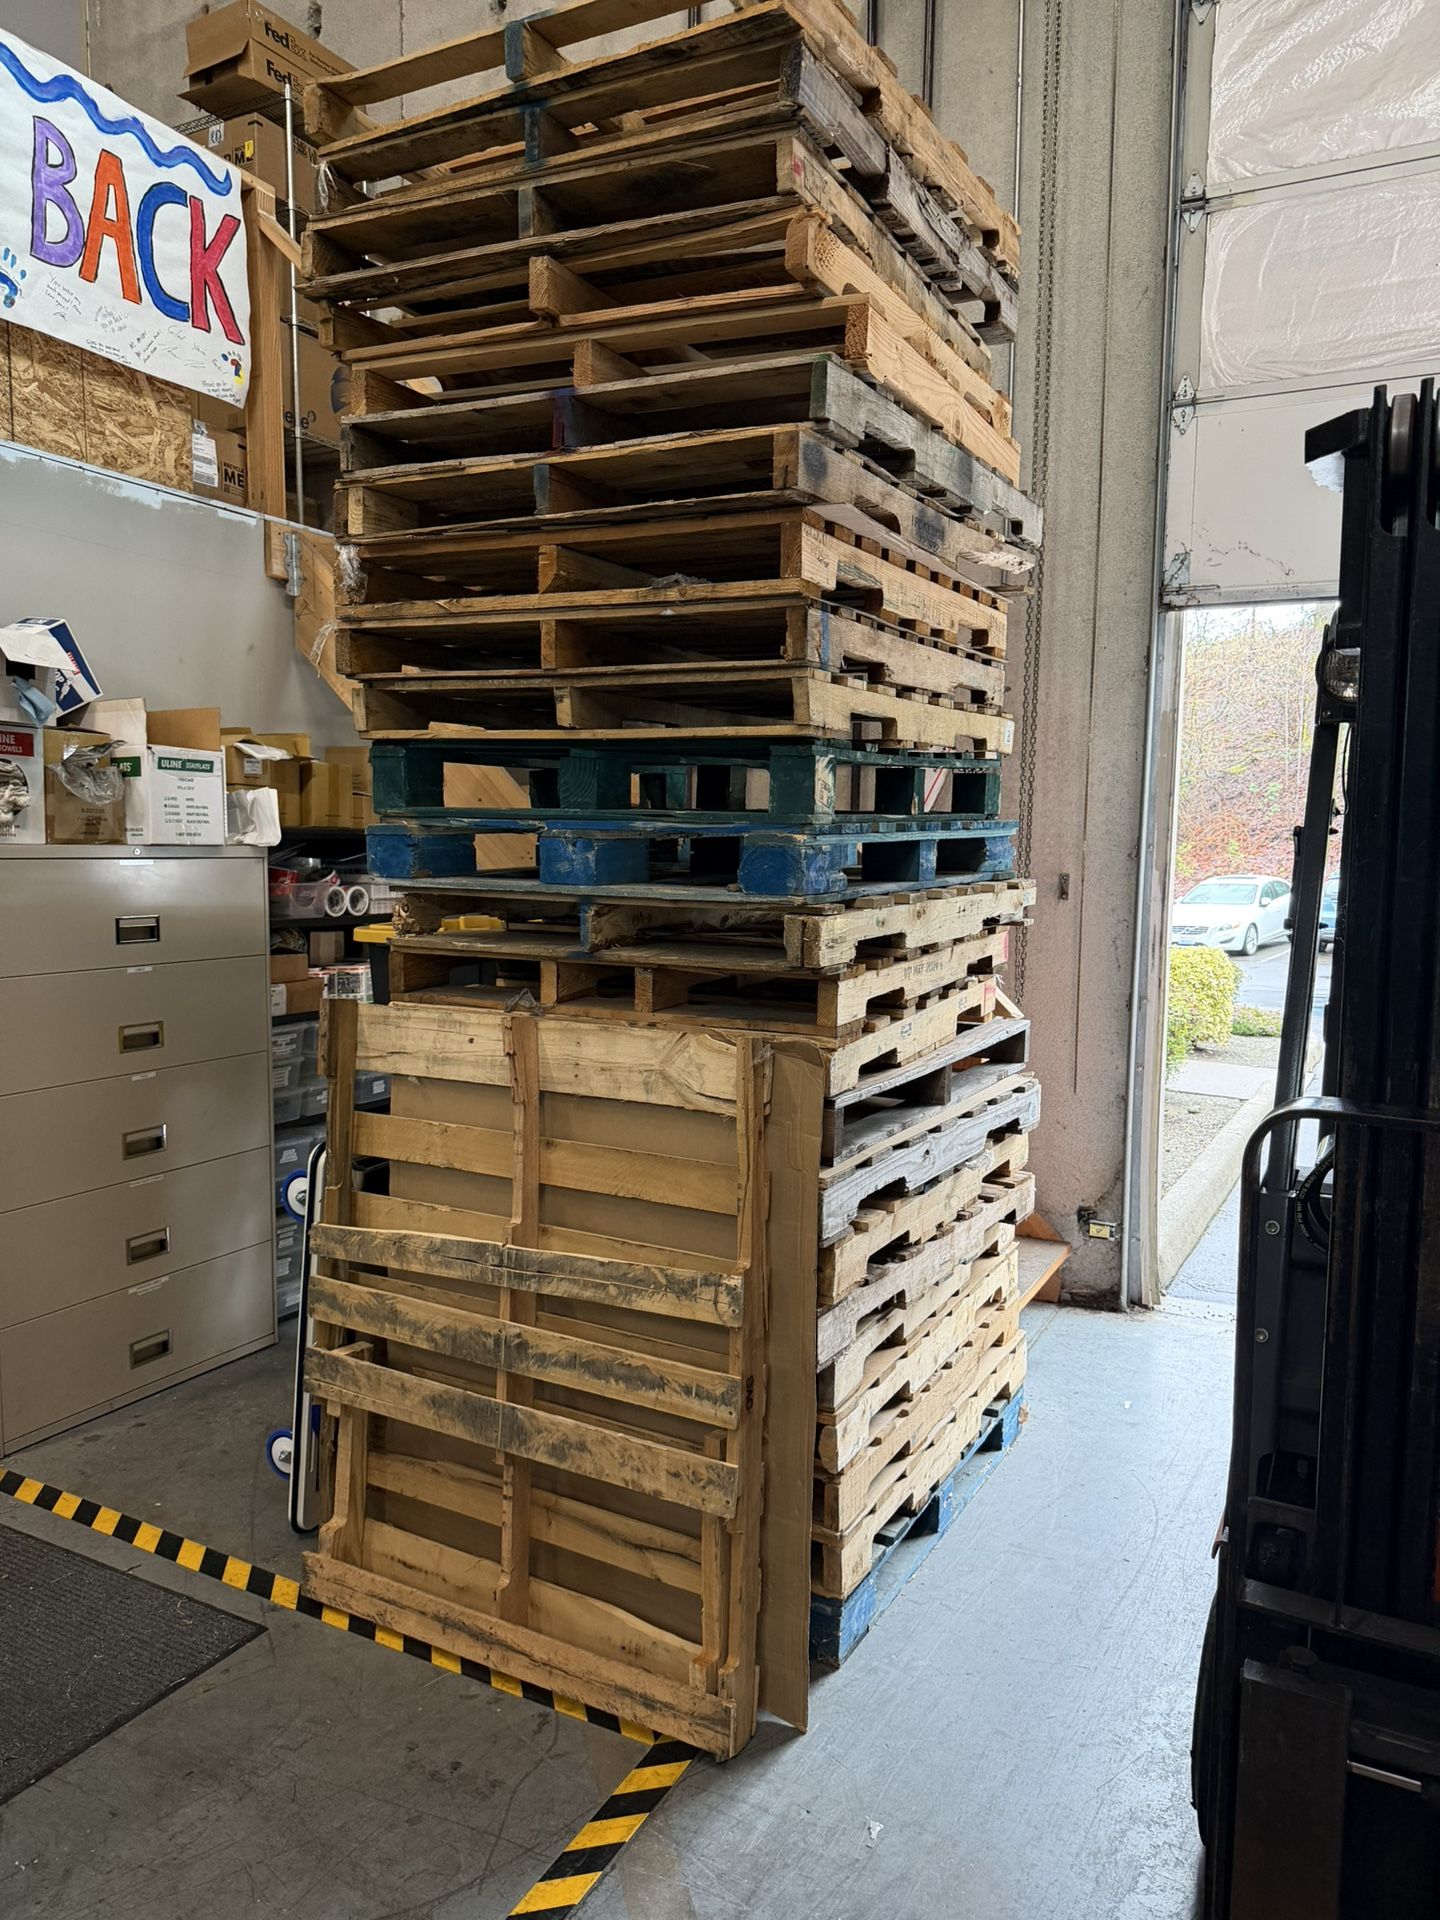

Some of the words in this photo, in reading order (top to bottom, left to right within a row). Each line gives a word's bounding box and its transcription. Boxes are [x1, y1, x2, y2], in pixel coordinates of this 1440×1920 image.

[264, 20, 308, 60] FedEx
[30, 115, 246, 346] BACK
[224, 468, 245, 489] ME
[160, 759, 183, 769] ULINE
